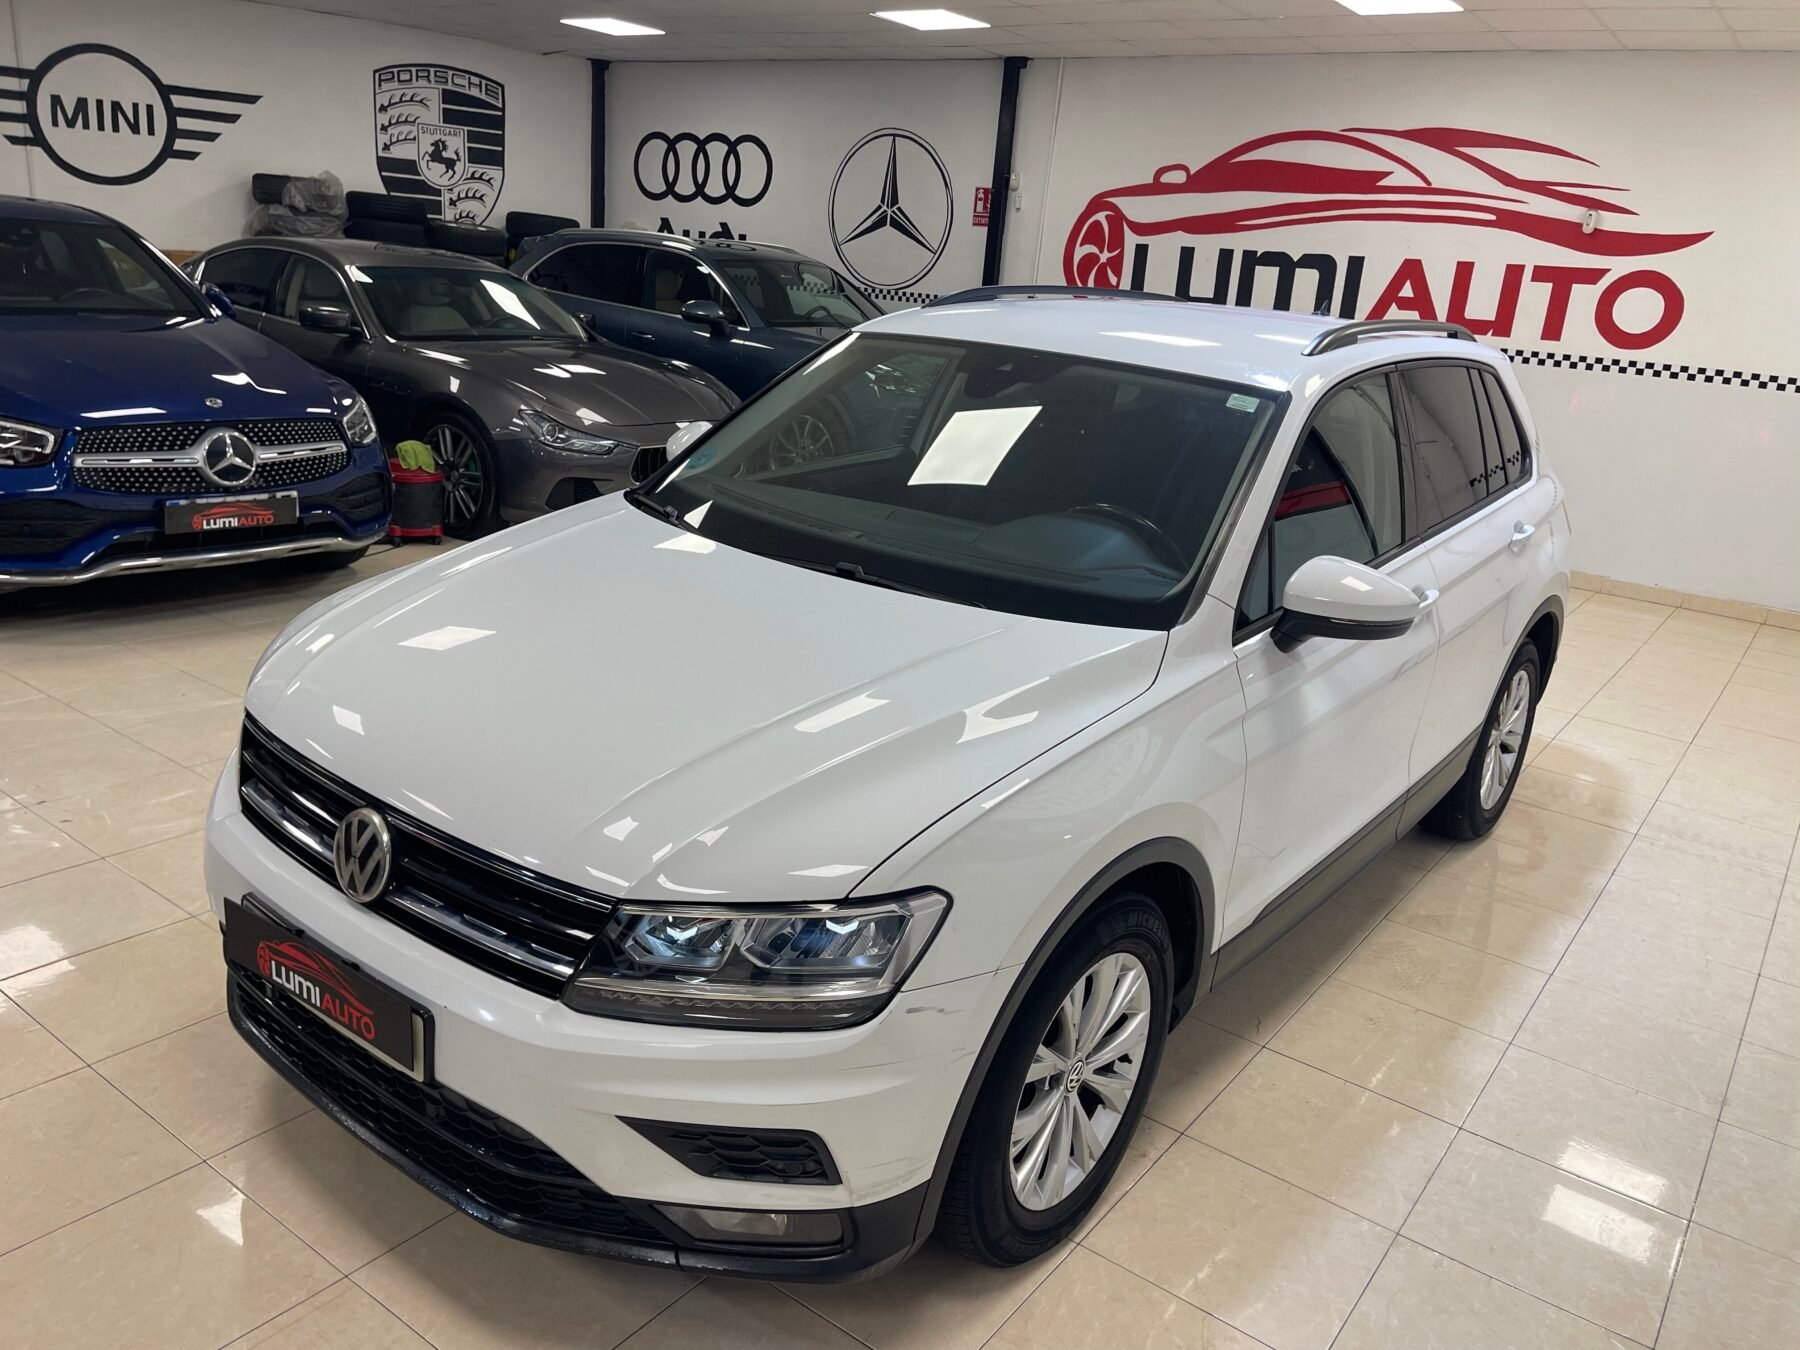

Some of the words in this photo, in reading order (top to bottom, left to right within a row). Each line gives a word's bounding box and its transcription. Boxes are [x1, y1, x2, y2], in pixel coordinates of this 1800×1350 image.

[377, 69, 500, 104] PORSCHE
[50, 94, 155, 136] MINI
[420, 126, 461, 138] STUTTGART
